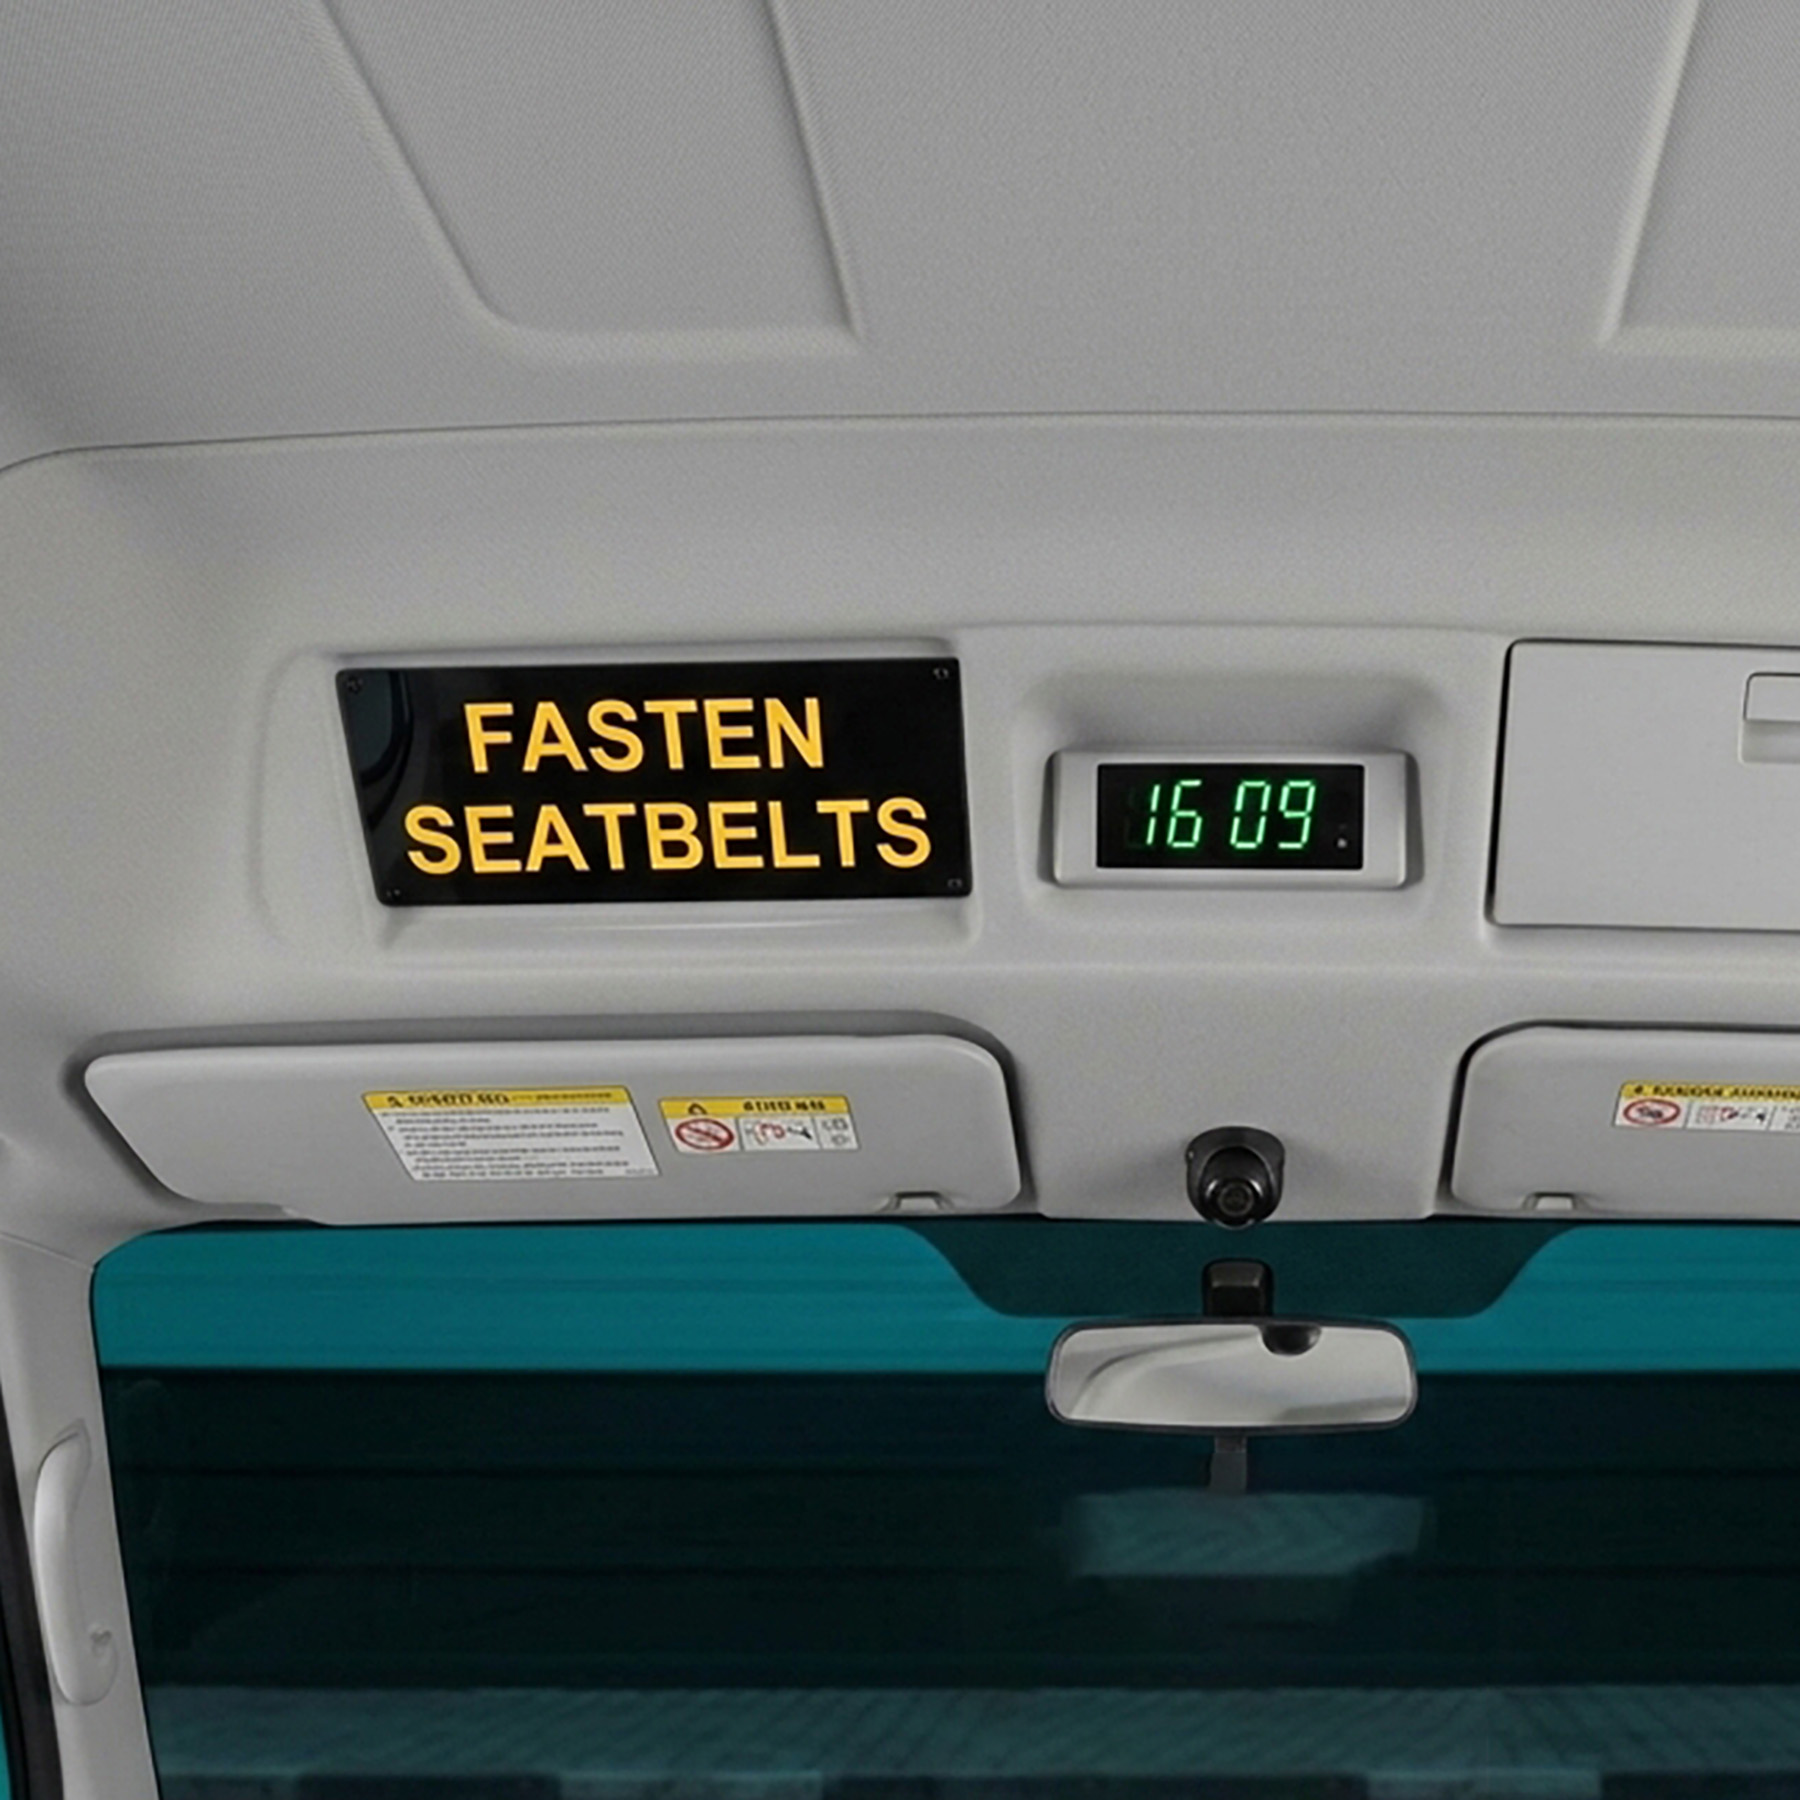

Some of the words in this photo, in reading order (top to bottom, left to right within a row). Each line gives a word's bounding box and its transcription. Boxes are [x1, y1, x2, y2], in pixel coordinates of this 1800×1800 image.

[464, 697, 824, 773] FASTEN
[404, 797, 931, 875] SEATBELTS
[1146, 779, 1203, 849] 16
[1229, 779, 1317, 850] 09
